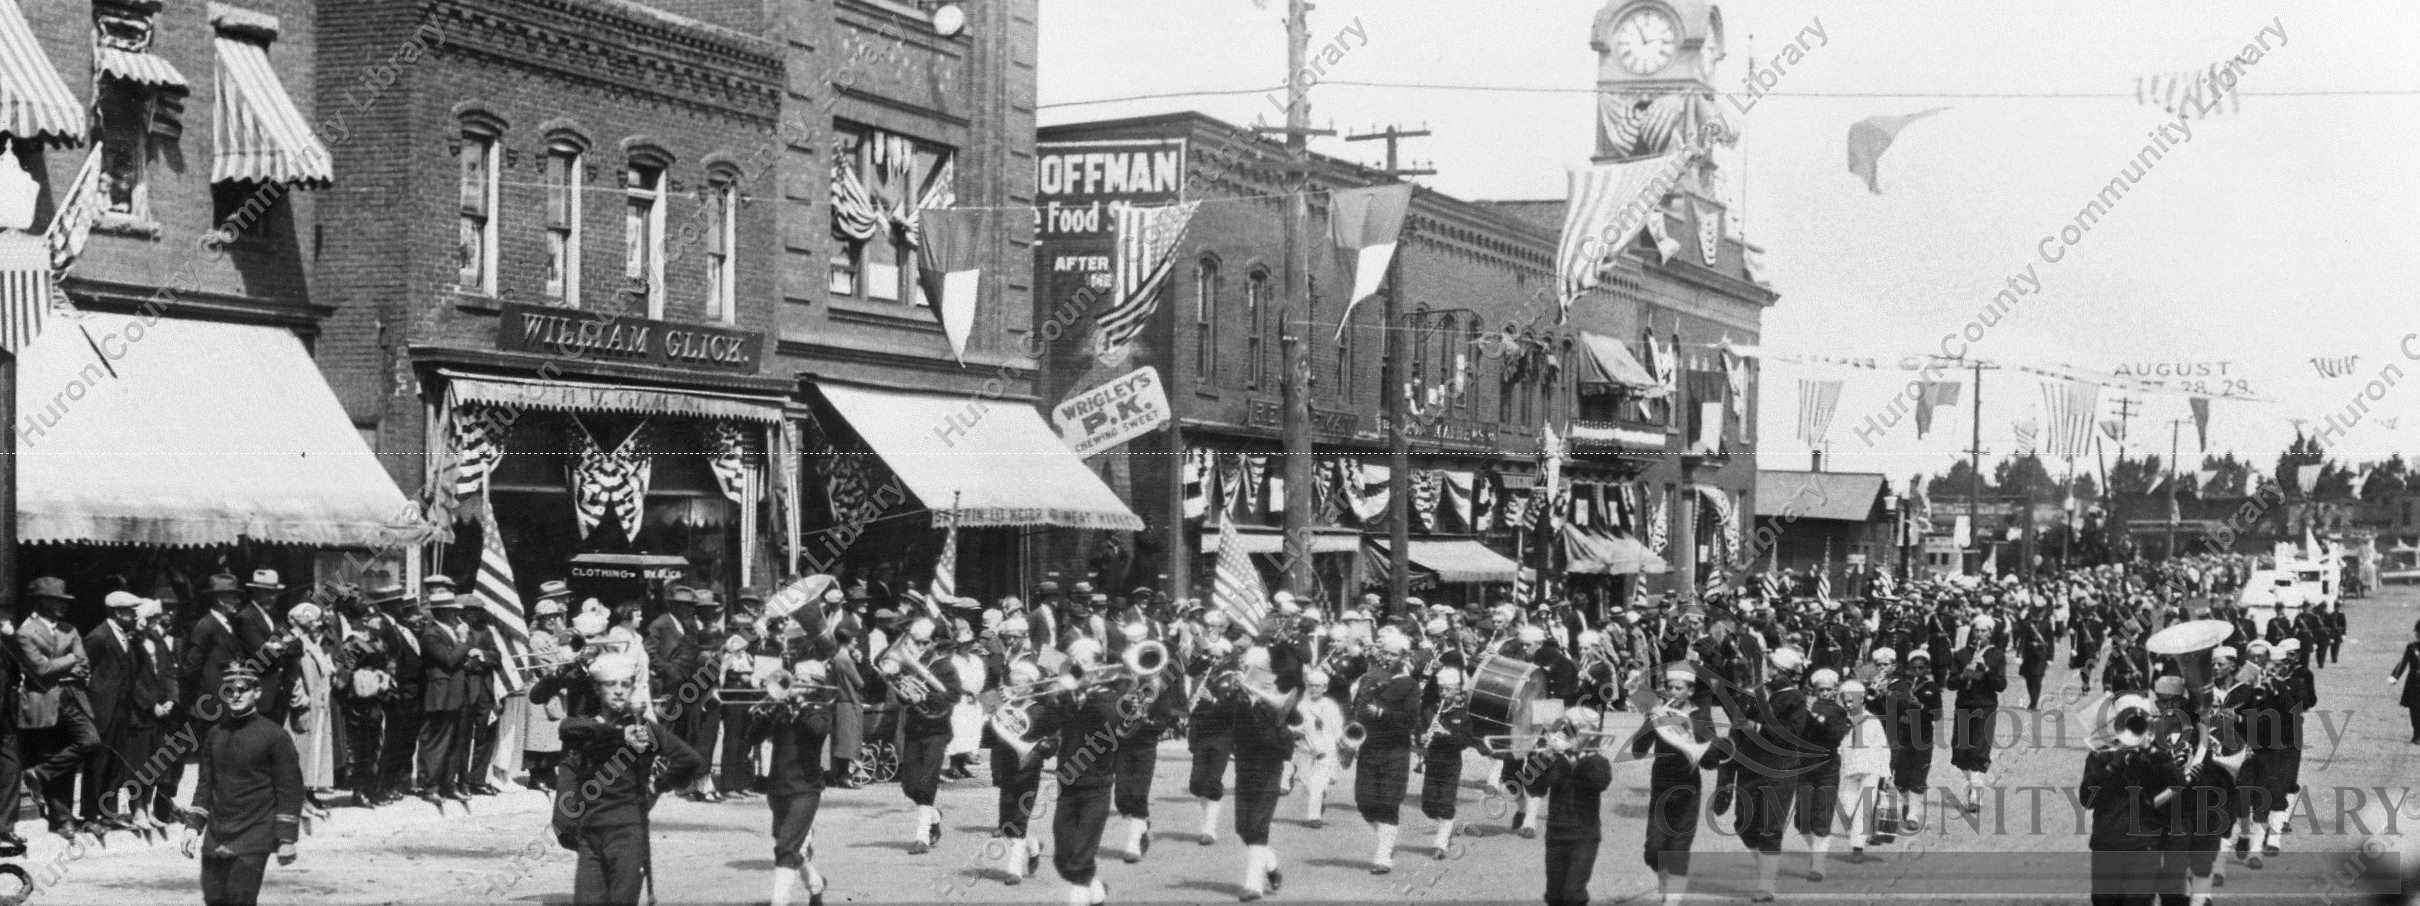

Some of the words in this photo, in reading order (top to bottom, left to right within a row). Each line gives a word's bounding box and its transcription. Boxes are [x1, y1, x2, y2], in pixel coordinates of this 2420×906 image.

[1035, 151, 1177, 195] OFFMAN
[1048, 200, 1099, 233] Food
[1054, 256, 1110, 272] AFTER
[521, 312, 649, 354] WILLIAM
[665, 329, 750, 364] GLICK.
[2114, 361, 2232, 377] AUGUST
[1075, 427, 1119, 452] CHEWING
[1122, 410, 1158, 433] SWEET
[1082, 394, 1152, 436] P.K.
[571, 567, 629, 579] CLOTHING
